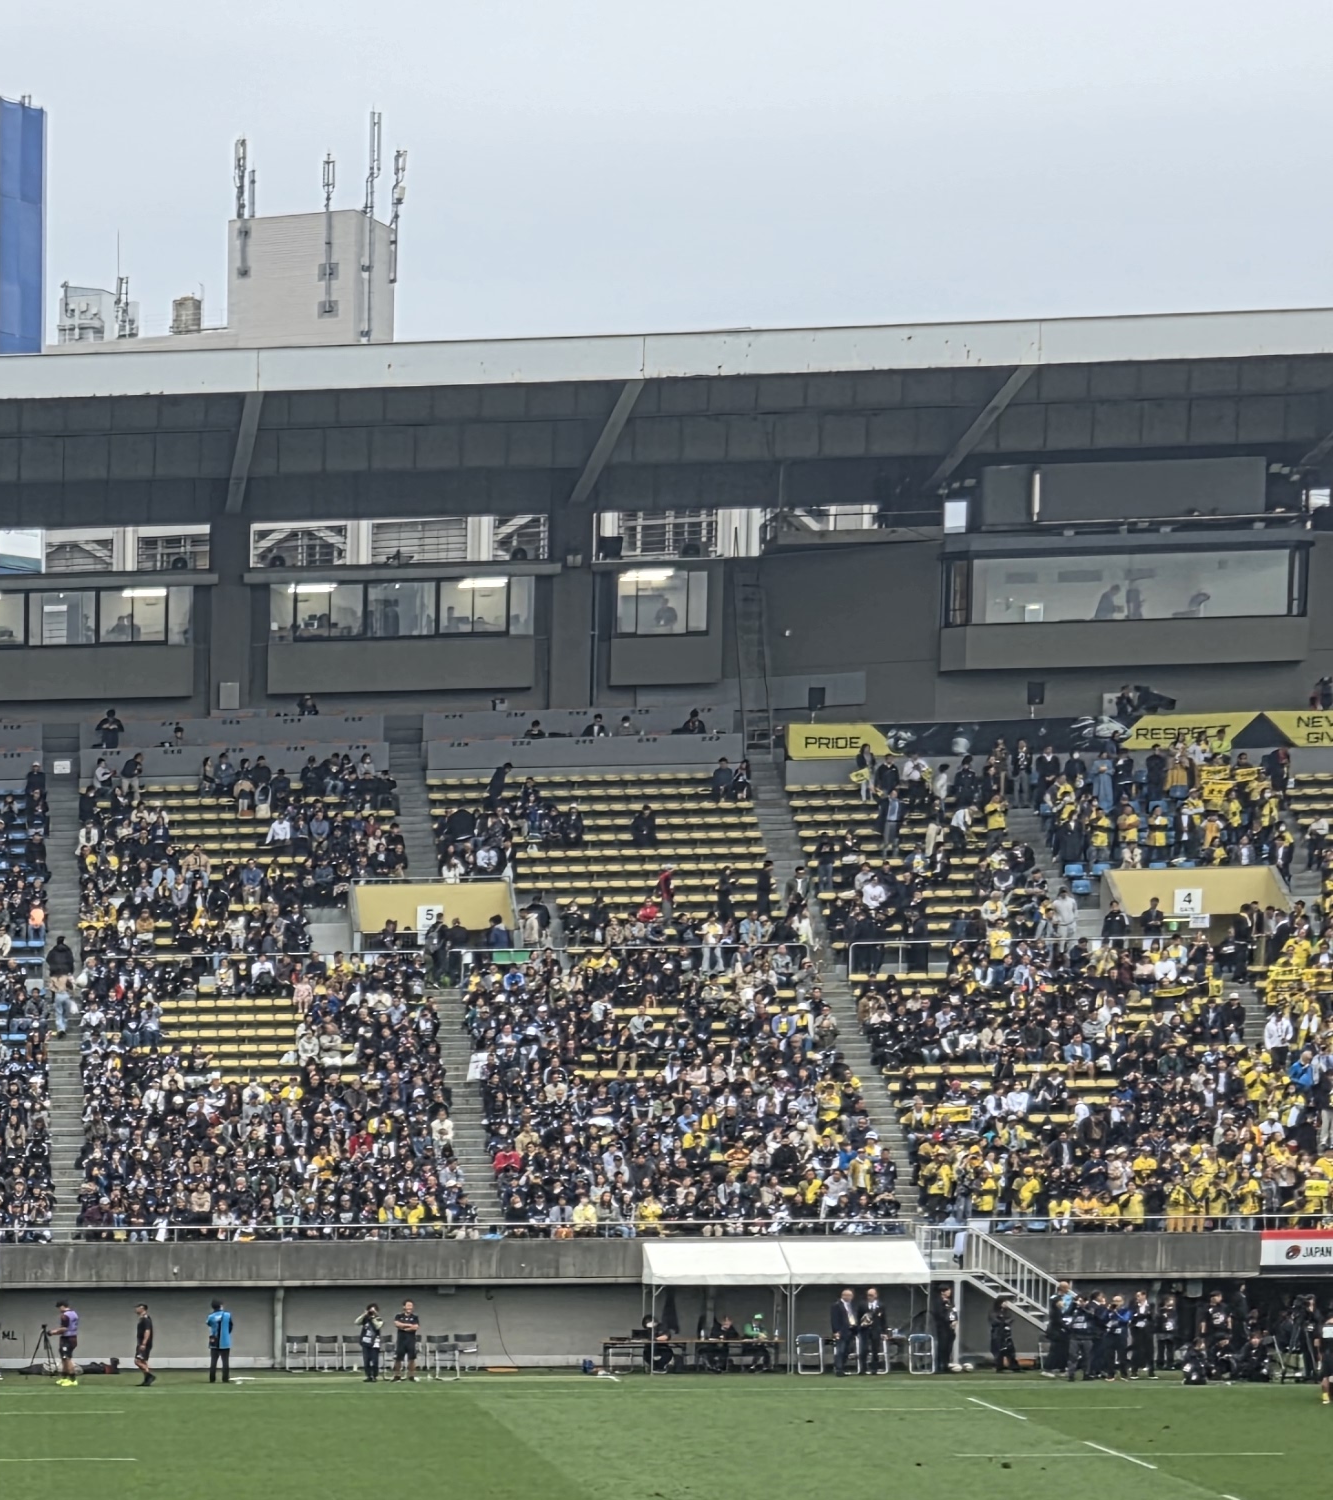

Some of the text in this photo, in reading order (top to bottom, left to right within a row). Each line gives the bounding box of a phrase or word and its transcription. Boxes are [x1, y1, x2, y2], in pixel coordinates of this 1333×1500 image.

[804, 736, 862, 750] PRIDE
[1182, 892, 1193, 905] 4
[425, 909, 434, 921] 5
[1302, 1246, 1332, 1258] JAPAN
